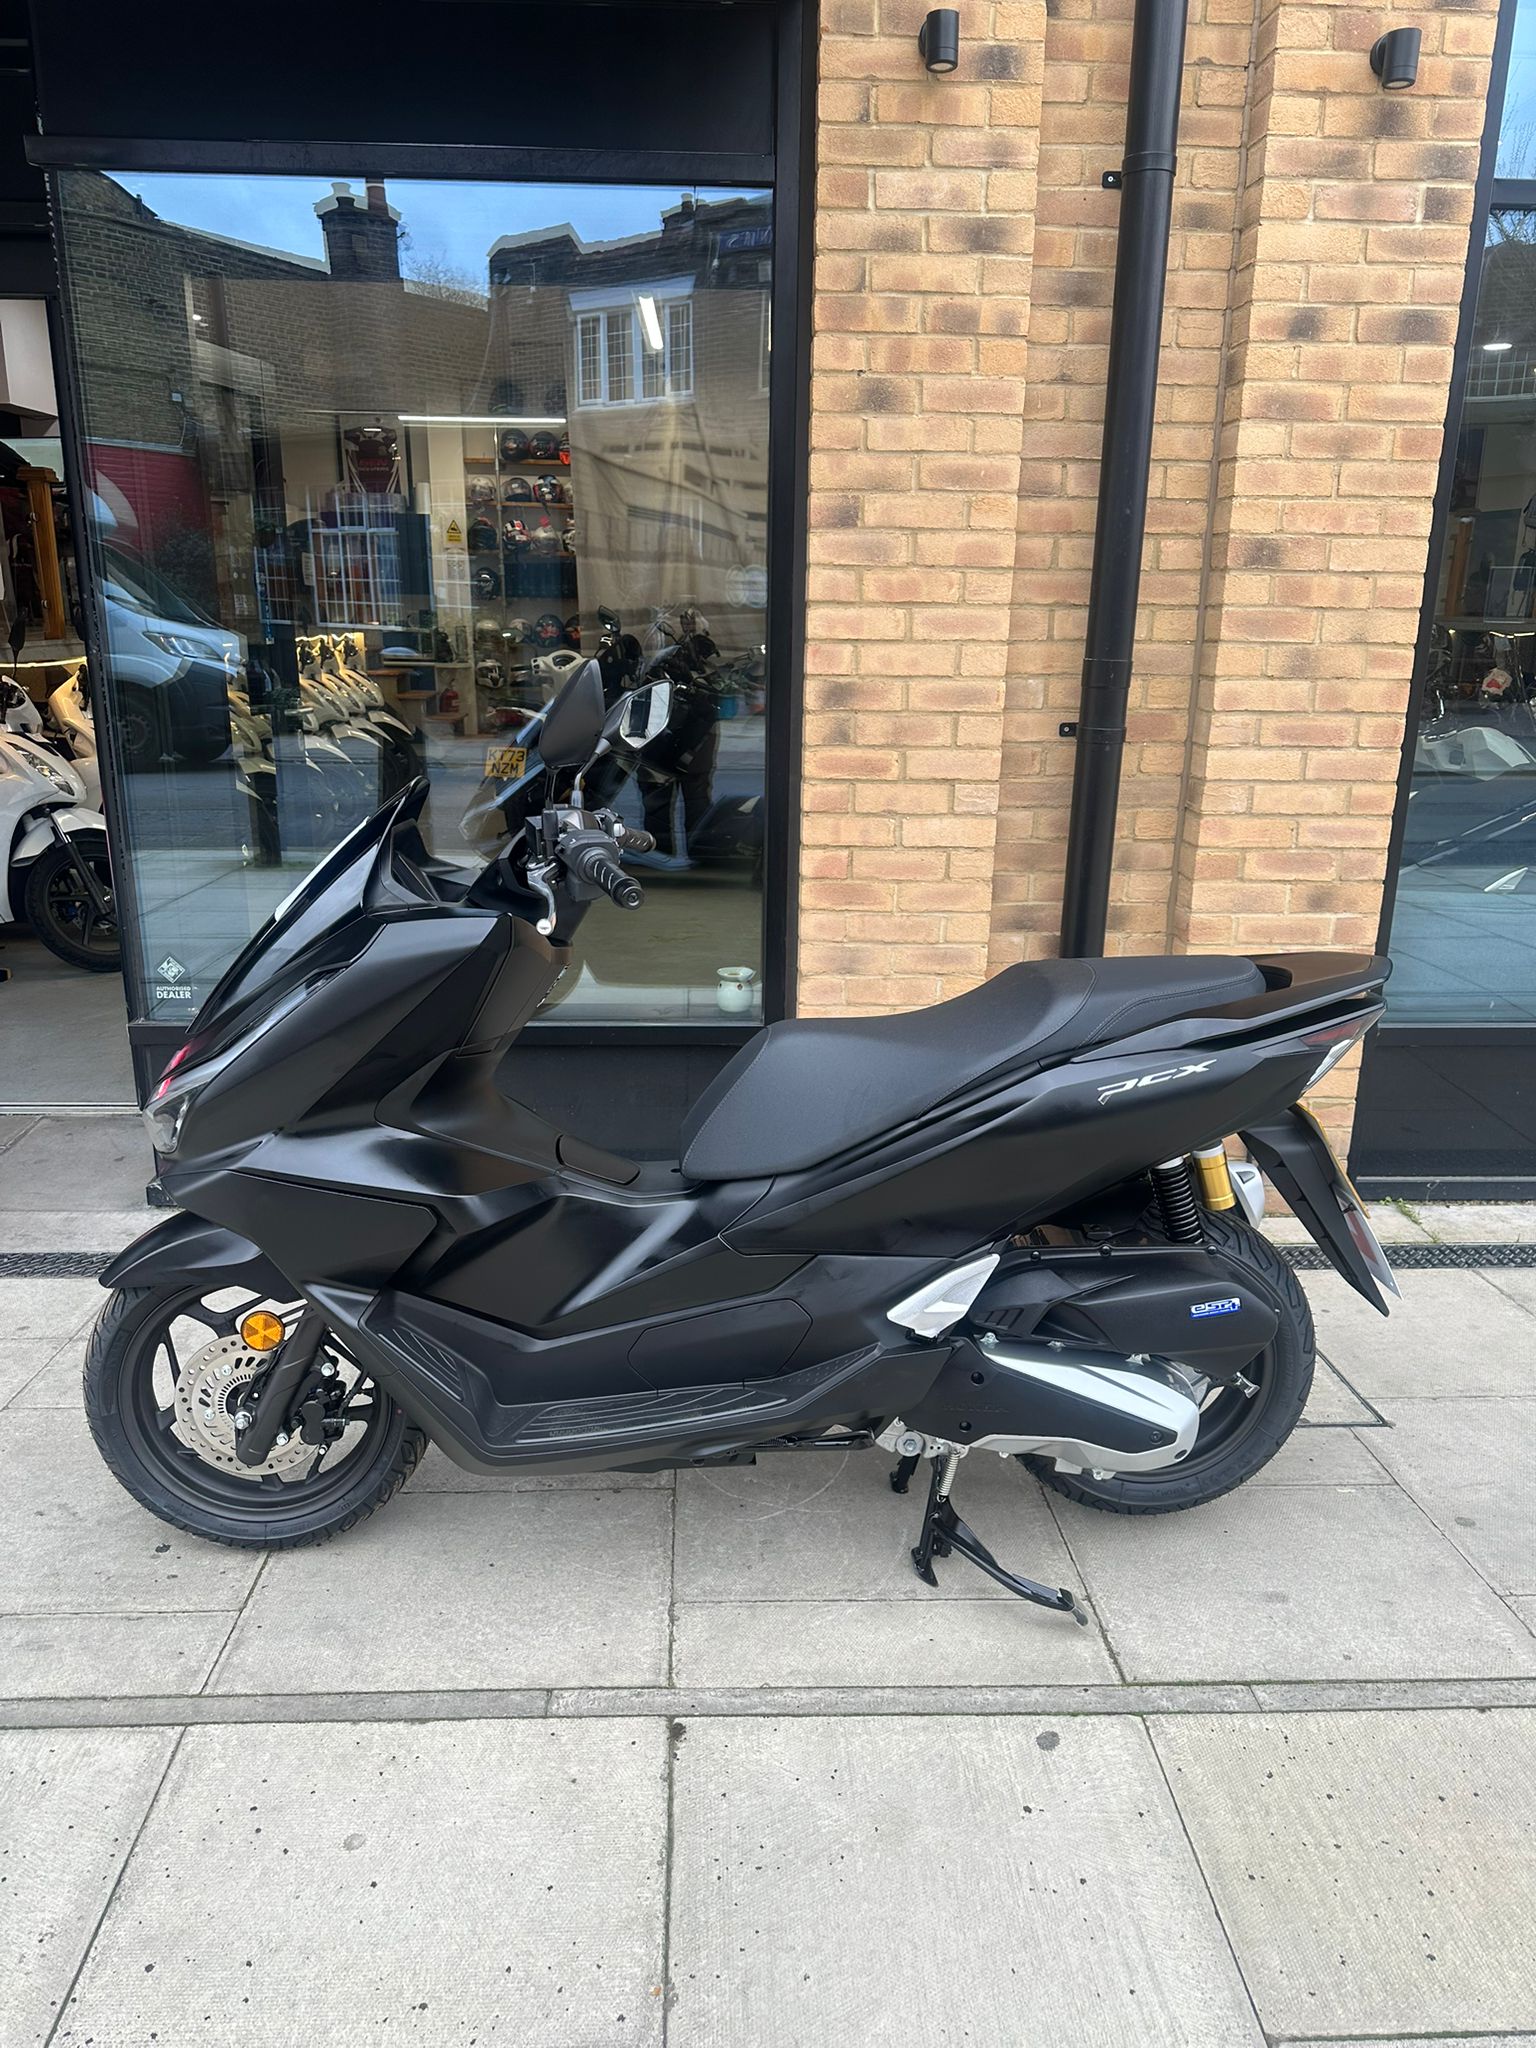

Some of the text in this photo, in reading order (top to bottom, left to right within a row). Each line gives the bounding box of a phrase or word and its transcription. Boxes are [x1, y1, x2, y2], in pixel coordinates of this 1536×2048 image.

[491, 763, 519, 774] NZM
[156, 991, 192, 999] DEALER
[1097, 1059, 1217, 1105] PCX
